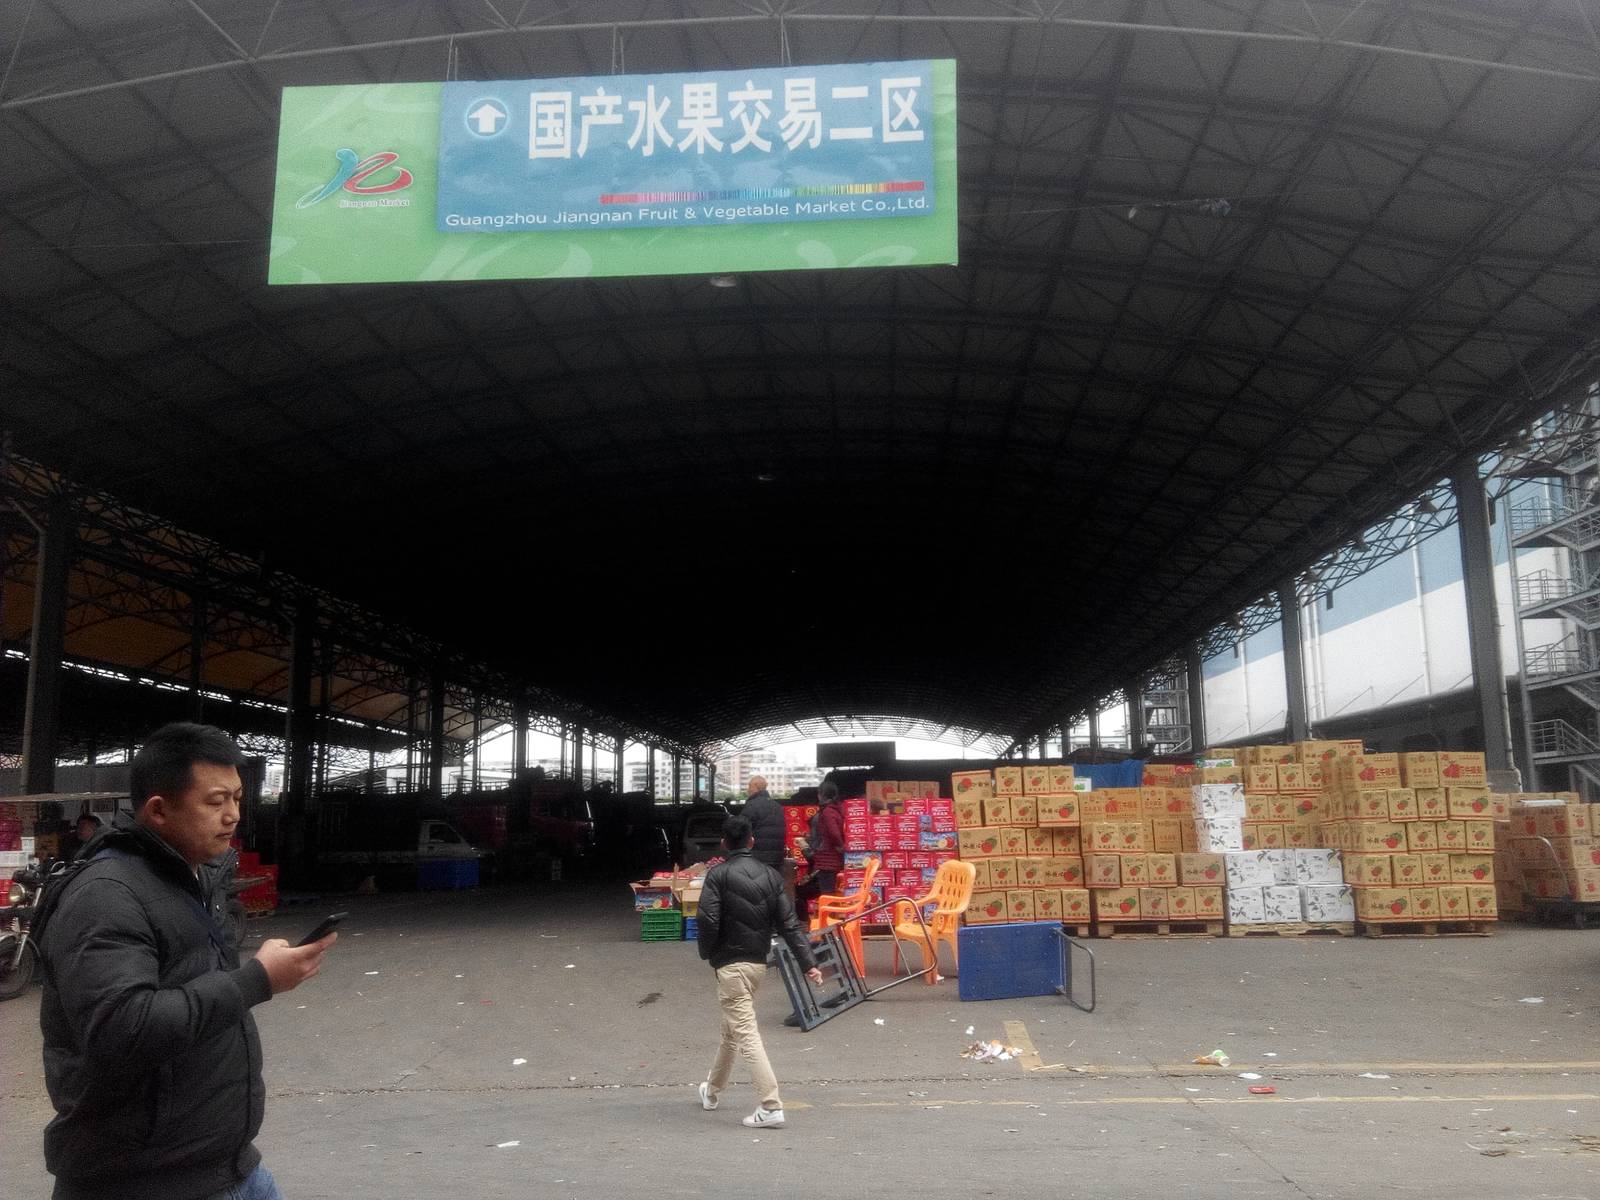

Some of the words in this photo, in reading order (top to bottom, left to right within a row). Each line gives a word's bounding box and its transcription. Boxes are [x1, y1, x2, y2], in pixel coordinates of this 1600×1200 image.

[528, 75, 925, 160] 国产水果交易二区
[445, 213, 547, 227] Guangzhou
[553, 209, 632, 224] Jiangnan
[638, 207, 678, 220] Fruit
[684, 207, 697, 219] &
[703, 202, 789, 219] Vegetable
[796, 199, 856, 214] Market
[861, 197, 929, 212] Co.,Ltd.
